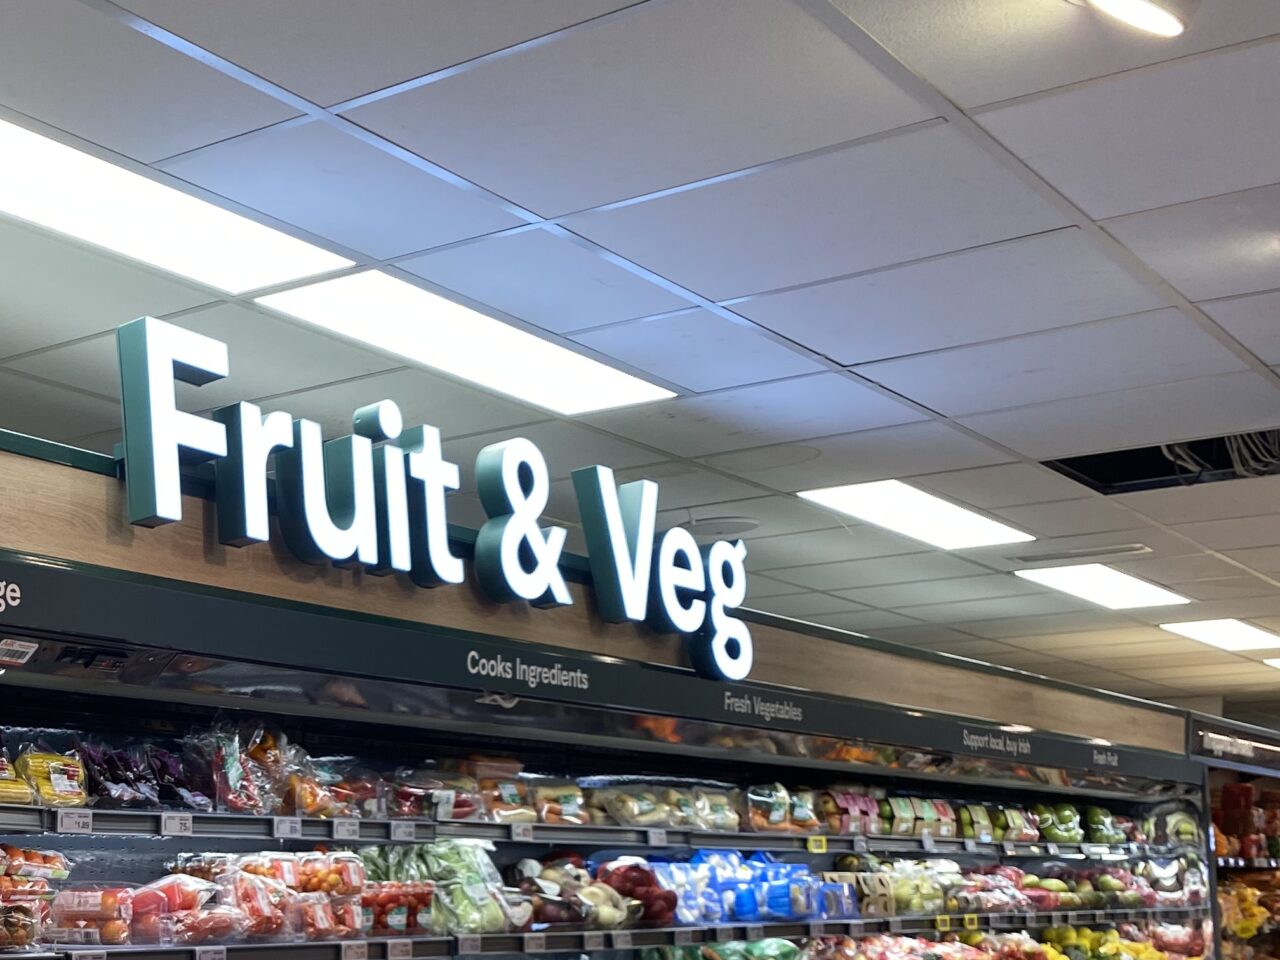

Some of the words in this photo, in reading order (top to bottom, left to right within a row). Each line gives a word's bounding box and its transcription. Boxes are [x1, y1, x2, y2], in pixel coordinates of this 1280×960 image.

[120, 316, 464, 586] Fruit
[475, 437, 573, 609] &
[571, 465, 753, 680] Veg
[467, 650, 512, 679] Cooks
[516, 654, 589, 689] Ingredients
[724, 692, 751, 714] Fresh
[752, 694, 803, 721] Vegetables
[963, 729, 989, 751] Support
